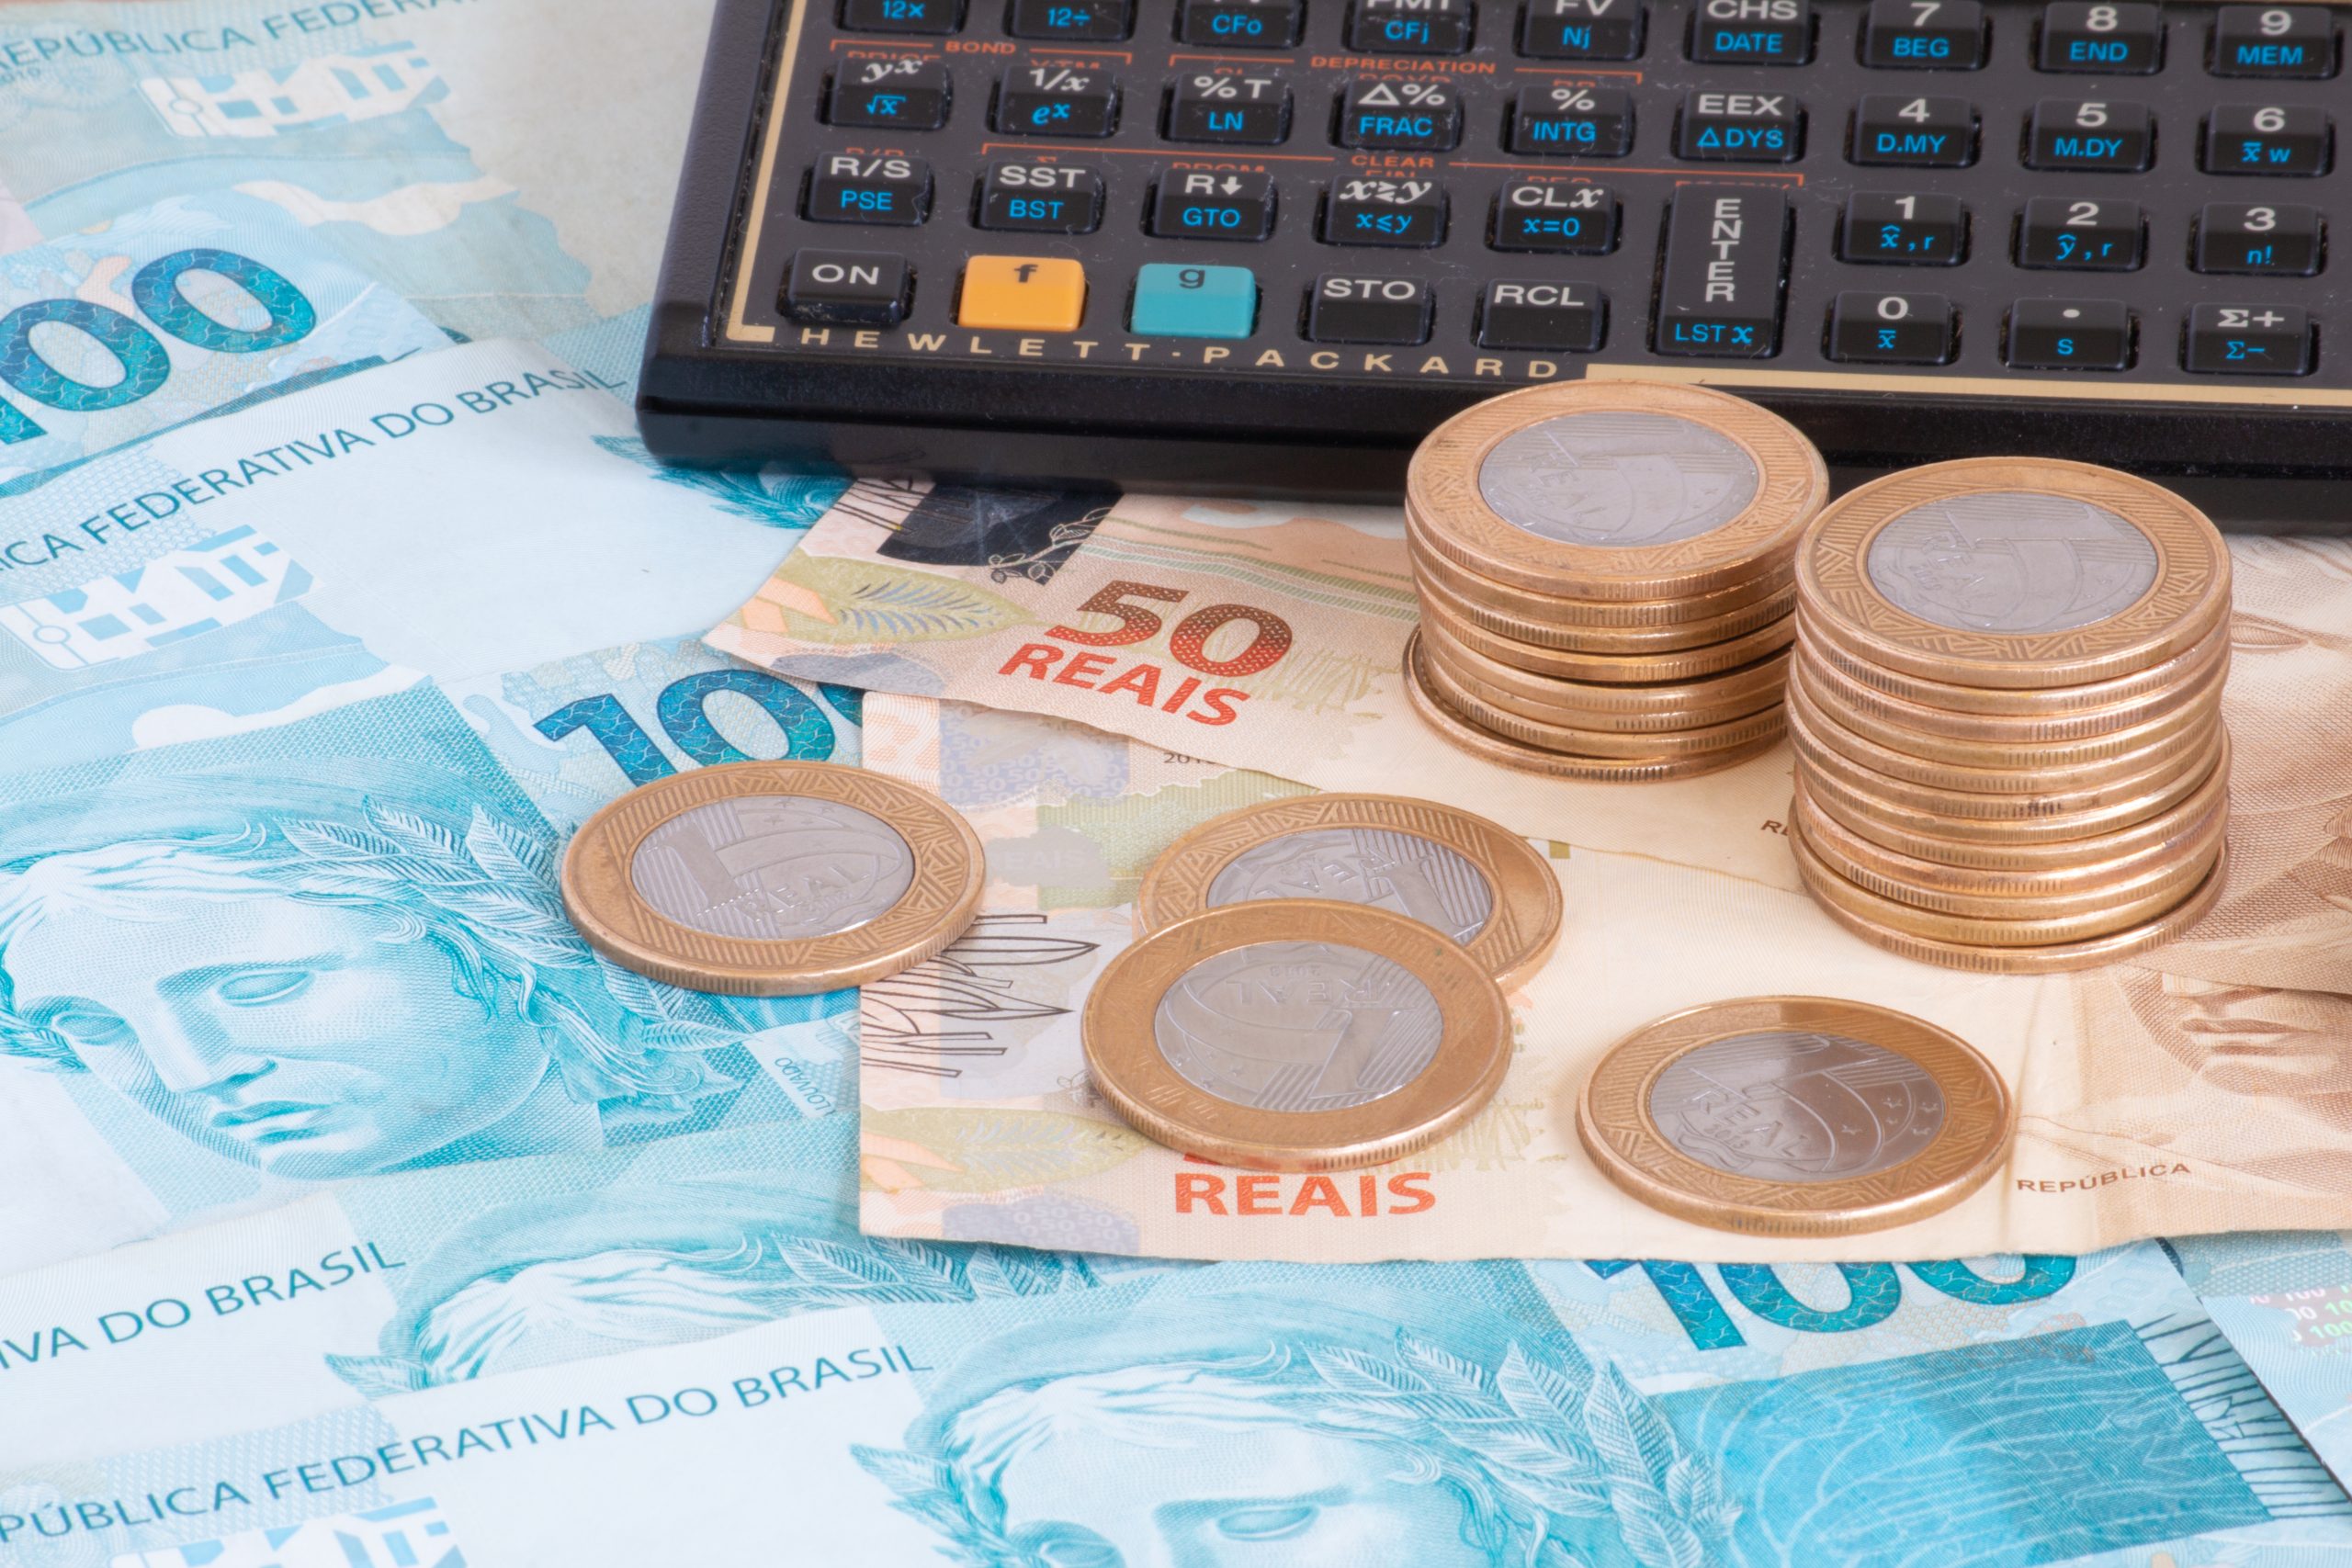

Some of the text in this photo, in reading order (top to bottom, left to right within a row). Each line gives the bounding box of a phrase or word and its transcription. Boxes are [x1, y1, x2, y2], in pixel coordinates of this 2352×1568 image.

[1708, 0, 1797, 19] CHS
[1912, 3, 1939, 26] 7
[2087, 6, 2117, 30] 8
[2262, 11, 2291, 35] 9
[0, 30, 254, 70] EPÚBLICA
[945, 40, 1015, 54] BOND
[1715, 32, 1781, 52] DATE
[1894, 38, 1949, 57] BEG
[2071, 42, 2128, 62] END
[1311, 57, 1496, 73] DEPRECIATION
[2238, 46, 2302, 64] MEM
[1552, 89, 1594, 110] %
[1699, 95, 1782, 115] EEX
[1209, 112, 1243, 130] LN
[1899, 99, 1929, 122] 4
[2076, 103, 2107, 127] 5
[2255, 107, 2284, 131] 6
[1360, 117, 1432, 137] FRAC
[1533, 122, 1596, 141] INTG
[1877, 134, 1945, 152] D.MY
[2055, 139, 2121, 157] M.DY
[831, 157, 910, 178] R/S
[1352, 155, 1433, 172] CLEAR
[1000, 165, 1085, 187] SST
[842, 190, 892, 210] PSE
[1010, 199, 1063, 219] BST
[1896, 197, 1915, 219] 1
[1182, 208, 1240, 228] GTO
[2067, 202, 2098, 225] 2
[2245, 208, 2275, 231] 3
[1706, 199, 1742, 301] ENTER
[2247, 246, 2271, 264] n!
[812, 265, 878, 285] ON
[1013, 264, 1037, 283] f
[1181, 265, 1209, 287] g
[1324, 278, 1415, 299] STO
[1495, 285, 1583, 306] RCL
[1676, 324, 1725, 342] LST
[0, 248, 316, 446] 00
[800, 328, 1557, 379] HEWLETT-PACKARD
[80, 428, 376, 545] FEDERATIVA
[370, 402, 455, 438] DO
[459, 367, 628, 415] BRASIL
[1045, 579, 1293, 678] 50
[998, 642, 1250, 727] REAIS
[533, 669, 862, 787] 10
[2017, 1162, 2191, 1193] REPÚBLICA
[1175, 1171, 1436, 1218] REAIS
[98, 1298, 191, 1345] DO
[204, 1241, 406, 1316] BRASIL
[263, 1404, 616, 1500] FEDERATIVA
[626, 1387, 718, 1425] DO
[731, 1344, 933, 1408] BRASIL
